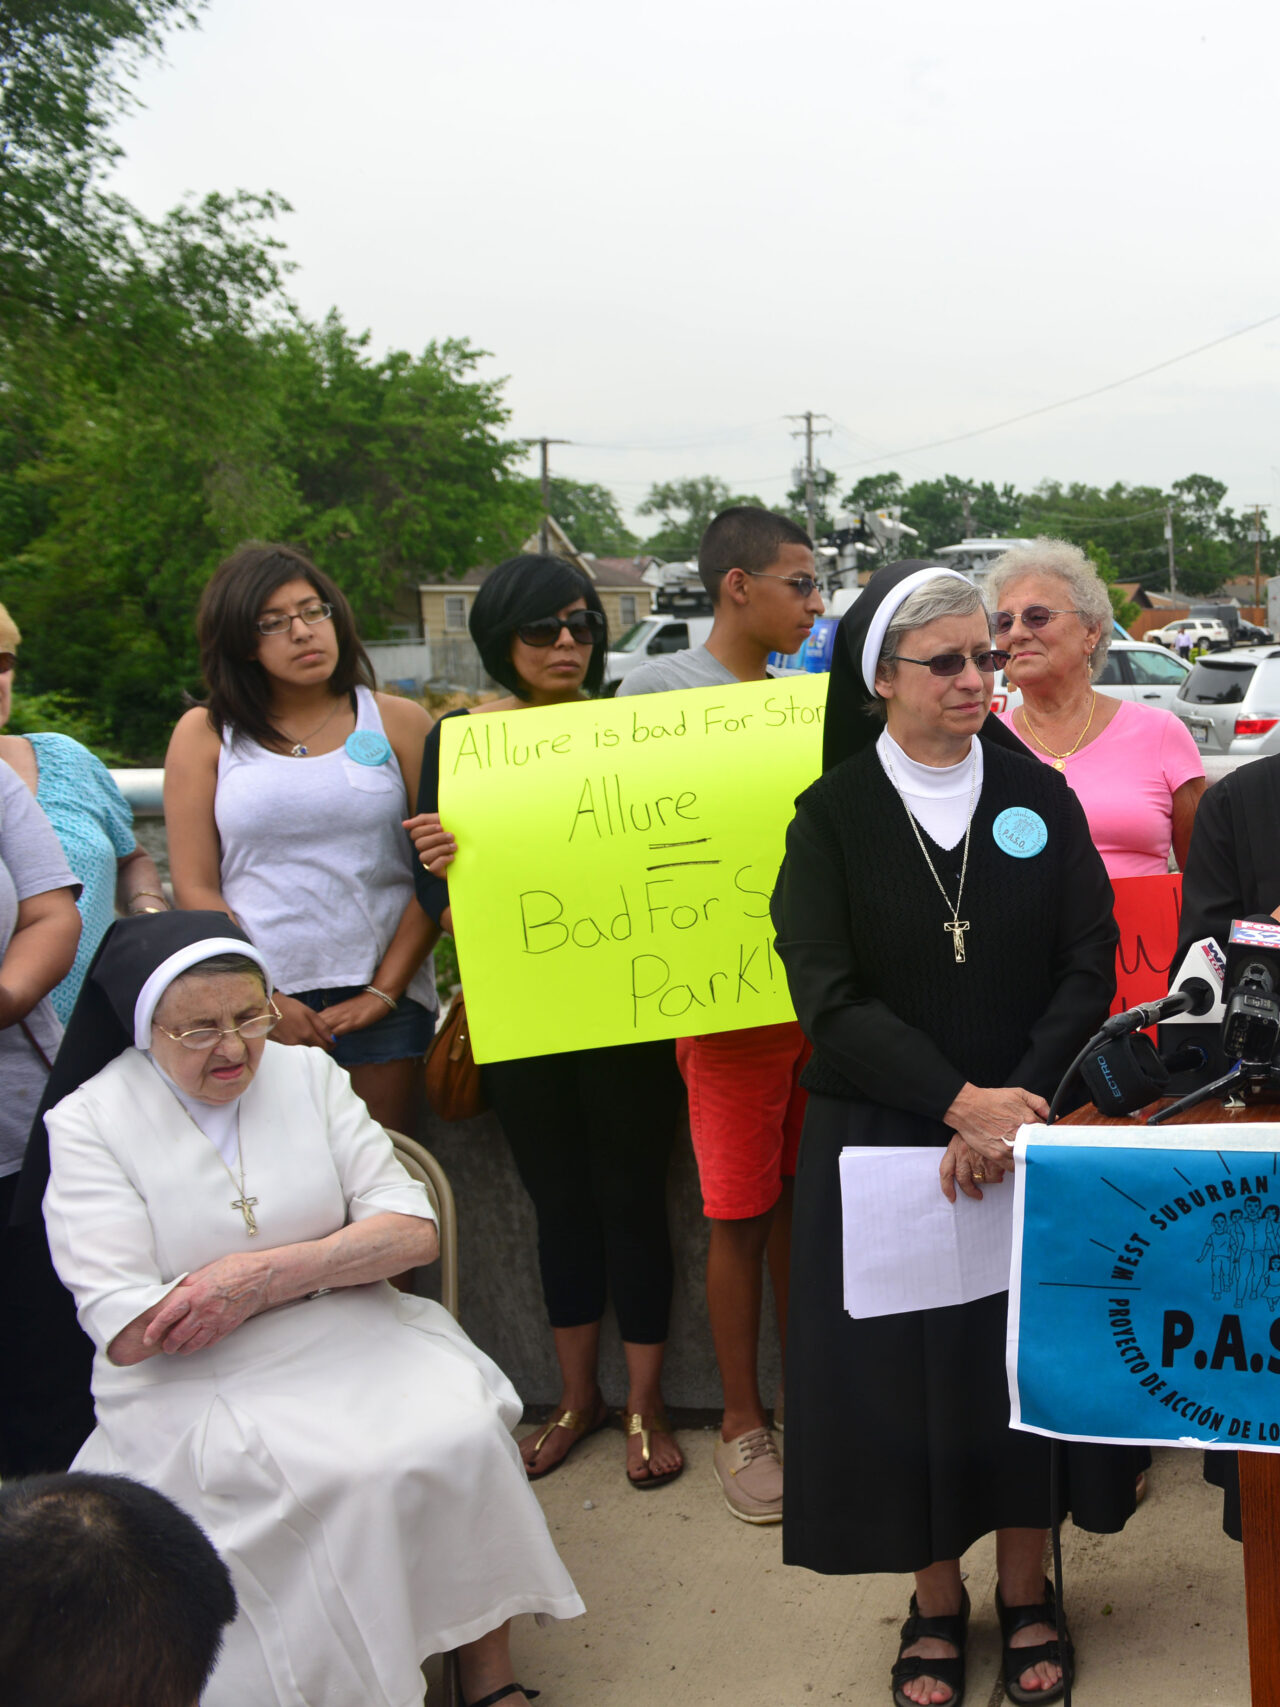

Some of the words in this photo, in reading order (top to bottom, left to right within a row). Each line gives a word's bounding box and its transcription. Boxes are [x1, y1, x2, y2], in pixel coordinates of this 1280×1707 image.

[452, 720, 572, 776] Allure
[594, 723, 620, 749] is
[632, 710, 688, 744] bad
[704, 705, 754, 736] For
[568, 773, 701, 843] Allure
[519, 884, 632, 955] Bad
[646, 878, 721, 935] For
[1110, 1233, 1152, 1282] WEST
[1149, 1175, 1270, 1231] SUBURBAN
[1109, 1298, 1149, 1377] PROYECTO
[1139, 1372, 1166, 1397] DE
[1159, 1393, 1224, 1433] ACCIÓN
[1228, 1420, 1252, 1440] DE
